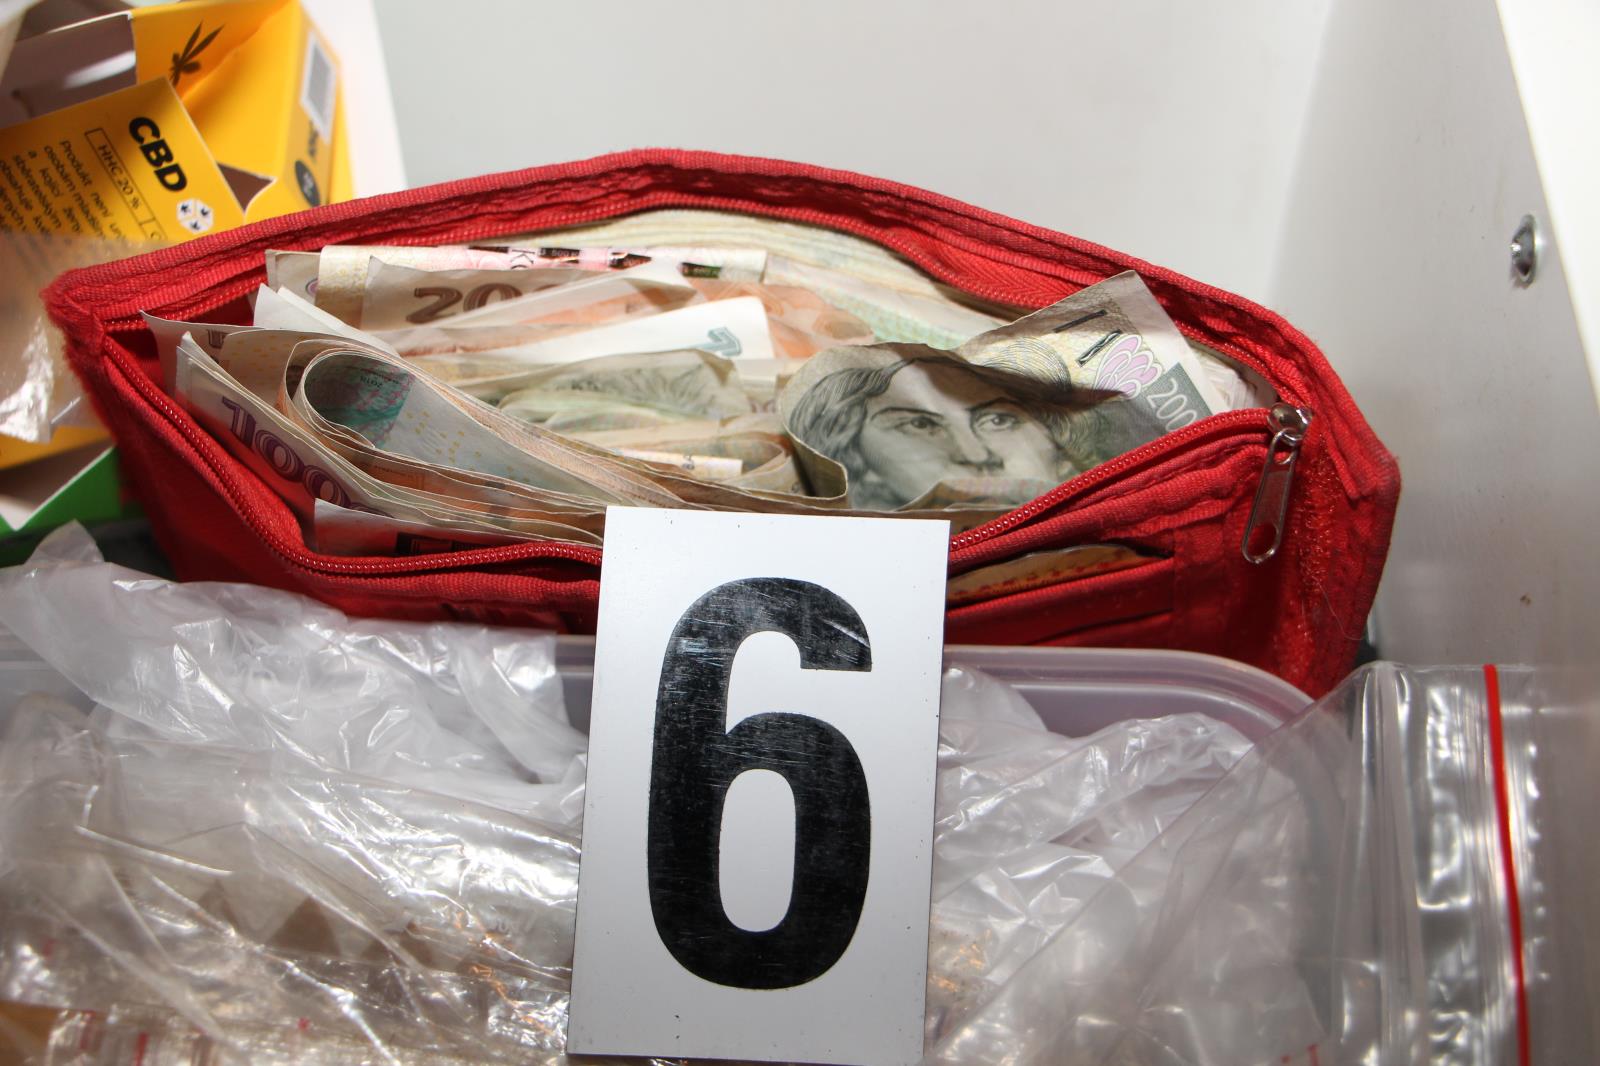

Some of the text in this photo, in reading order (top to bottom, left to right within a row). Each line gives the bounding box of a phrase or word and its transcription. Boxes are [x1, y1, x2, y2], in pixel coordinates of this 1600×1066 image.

[60, 140, 92, 187] Produkt
[98, 144, 141, 210] HHC 20 %
[128, 116, 188, 192] CBD
[1145, 377, 1198, 432] 200
[648, 577, 872, 989] 6
